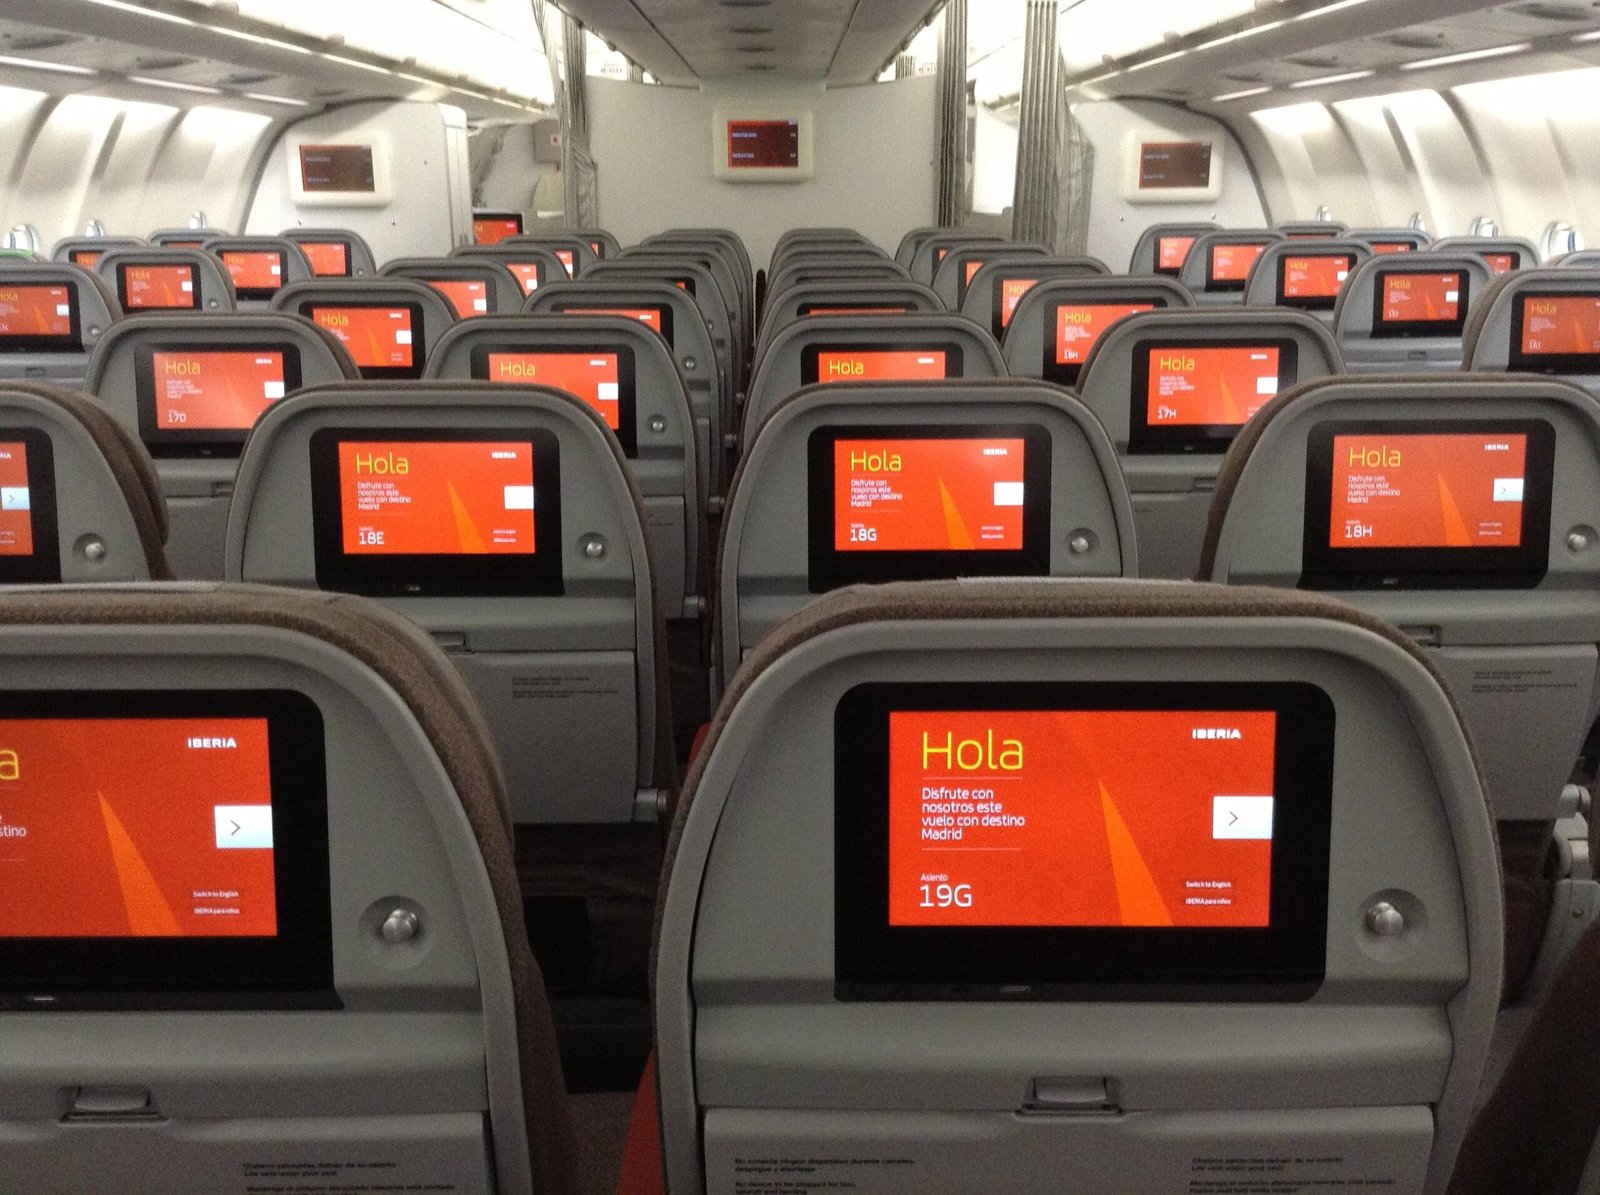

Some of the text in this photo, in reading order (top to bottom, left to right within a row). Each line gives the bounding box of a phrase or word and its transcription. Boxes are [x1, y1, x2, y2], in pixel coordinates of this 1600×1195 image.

[1531, 302, 1557, 315] Hola
[321, 313, 349, 326] Hola
[1065, 312, 1092, 324] Hola
[165, 360, 201, 375] Hola
[500, 360, 536, 377] Hola
[829, 359, 865, 375] Hola
[1160, 355, 1196, 371] Hola
[168, 412, 187, 423] 17D
[1157, 409, 1177, 419] 17H
[851, 449, 902, 472] Hola
[1349, 445, 1401, 467] Hola
[356, 453, 409, 474] Hola
[359, 531, 385, 545] 18E
[850, 528, 877, 542] 18G
[1345, 525, 1373, 538] 18H
[1191, 728, 1241, 739] IBERIA
[187, 738, 237, 748] IBERIA
[923, 728, 1023, 770] Hola
[922, 787, 994, 800] Disfrute con
[922, 801, 1002, 813] nosotros este
[922, 815, 1025, 826] vuelo con destino
[922, 828, 962, 840] Madrid
[920, 873, 948, 882] Asiento
[919, 884, 972, 907] 19G
